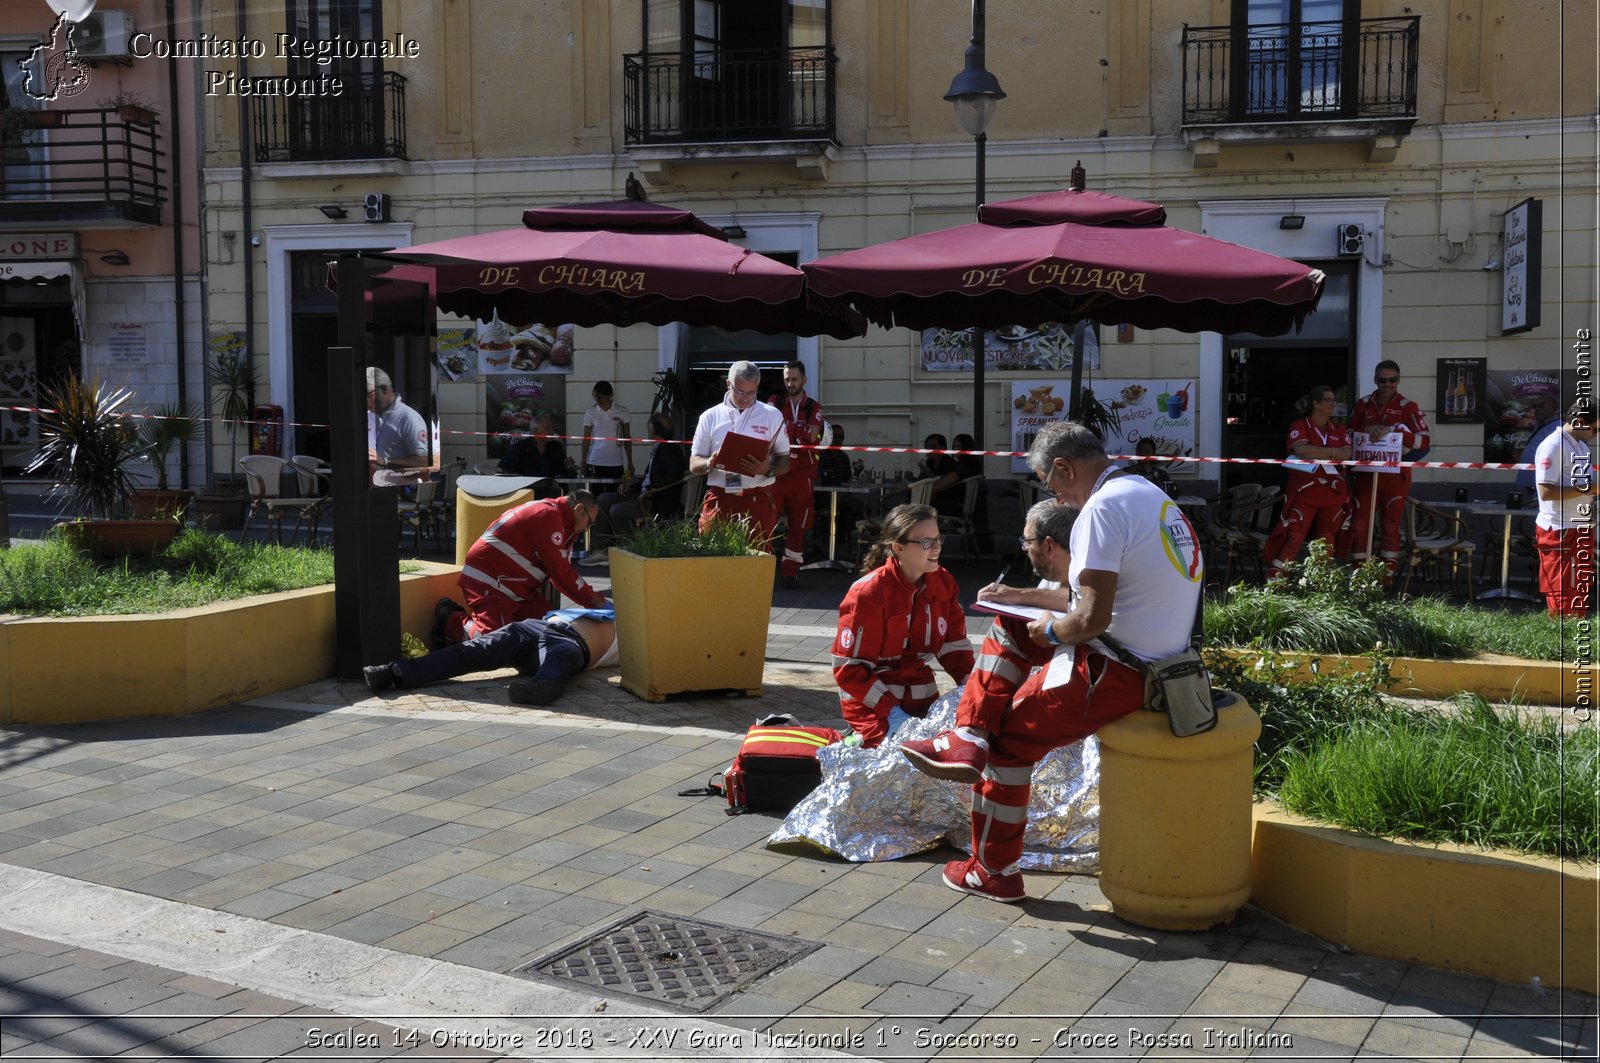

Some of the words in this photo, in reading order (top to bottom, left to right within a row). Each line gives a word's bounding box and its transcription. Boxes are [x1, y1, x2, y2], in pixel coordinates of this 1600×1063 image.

[0, 239, 69, 255] ONE
[479, 267, 520, 286] DE
[538, 264, 647, 293] CHIARA
[962, 267, 1007, 288] DE
[1028, 263, 1147, 295] CHIARA
[1154, 416, 1191, 431] Granite
[1354, 450, 1399, 465] PIEMONTE
